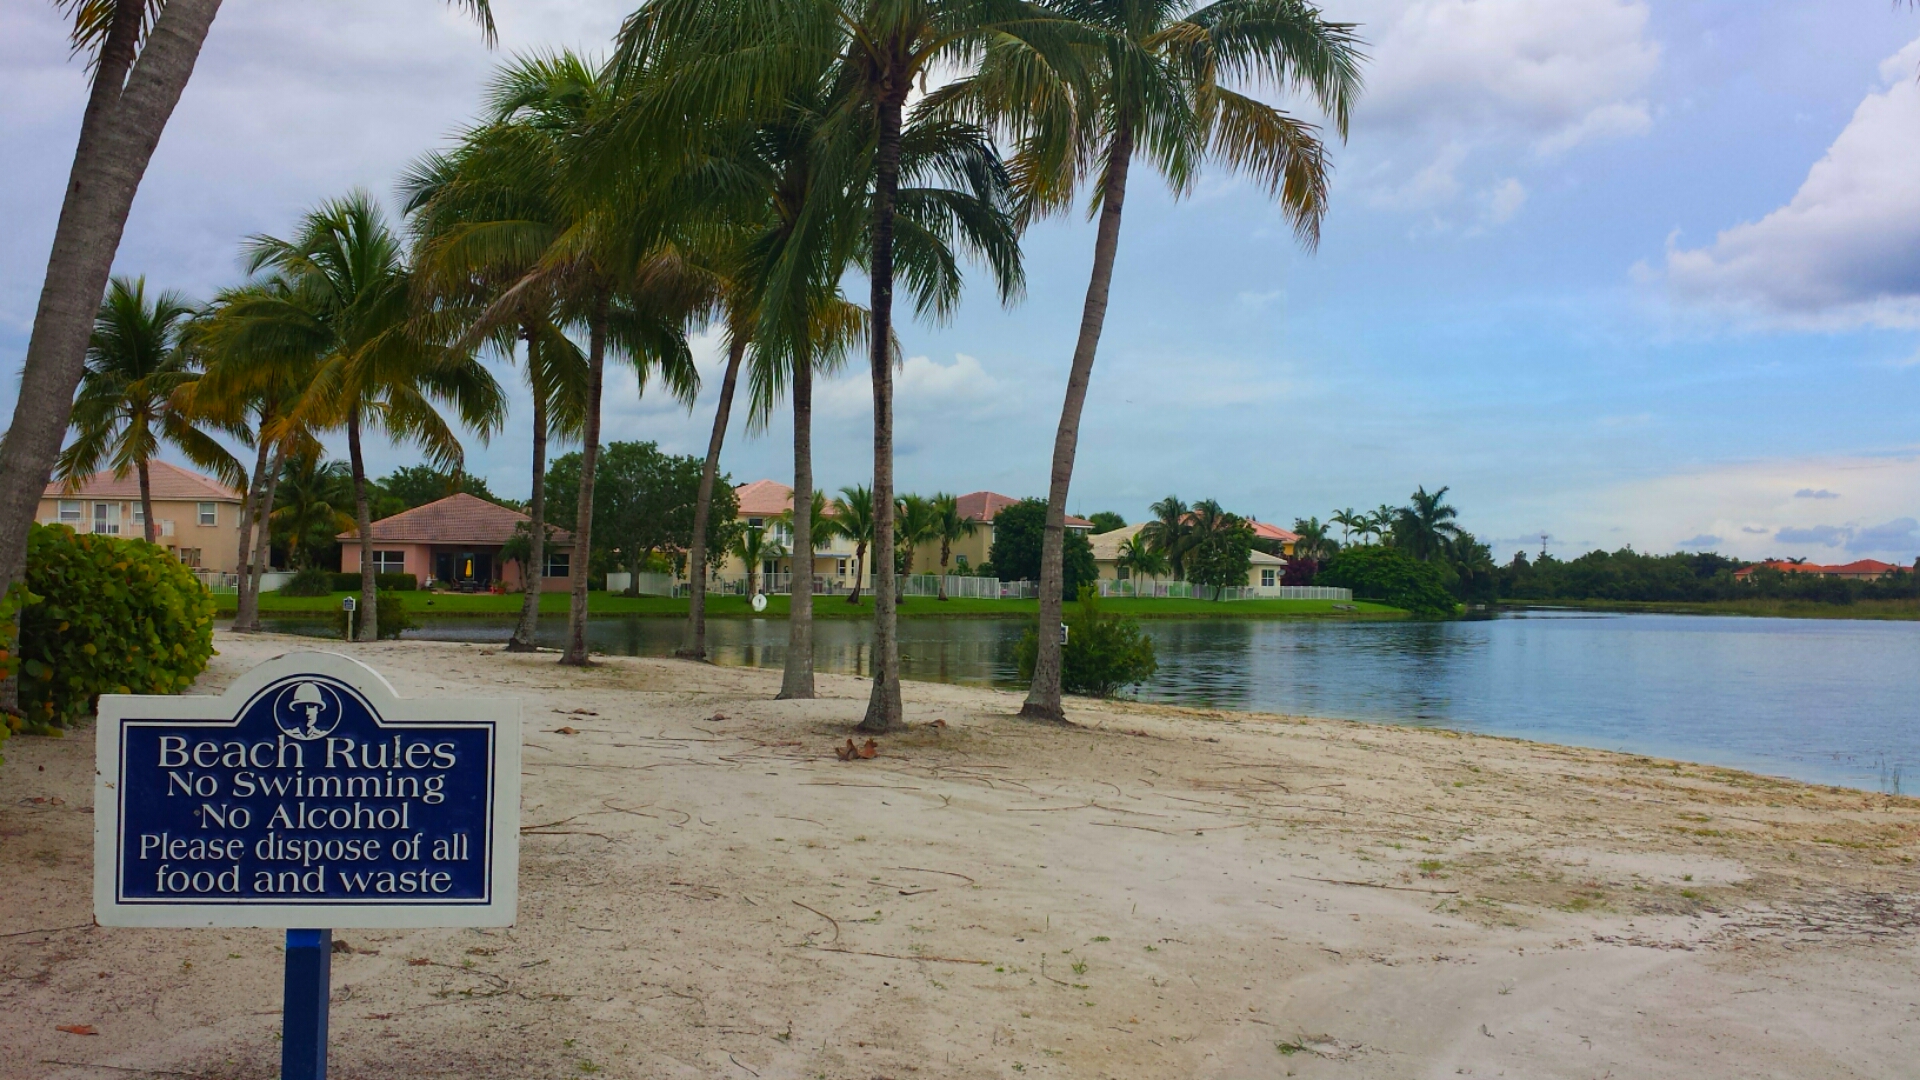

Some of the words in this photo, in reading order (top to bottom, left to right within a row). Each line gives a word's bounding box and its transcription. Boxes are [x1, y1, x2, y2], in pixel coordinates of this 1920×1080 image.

[158, 734, 303, 769] Beach
[325, 735, 457, 769] Rules
[167, 771, 218, 798] No
[232, 770, 446, 804] Swimming
[200, 804, 251, 829] No
[266, 802, 410, 830] Alcohol
[139, 834, 245, 861] Please
[255, 832, 381, 867] dispose
[391, 832, 423, 861] of
[432, 833, 469, 861] all
[155, 864, 240, 893] food
[253, 865, 325, 893] and
[339, 867, 453, 893] waste
